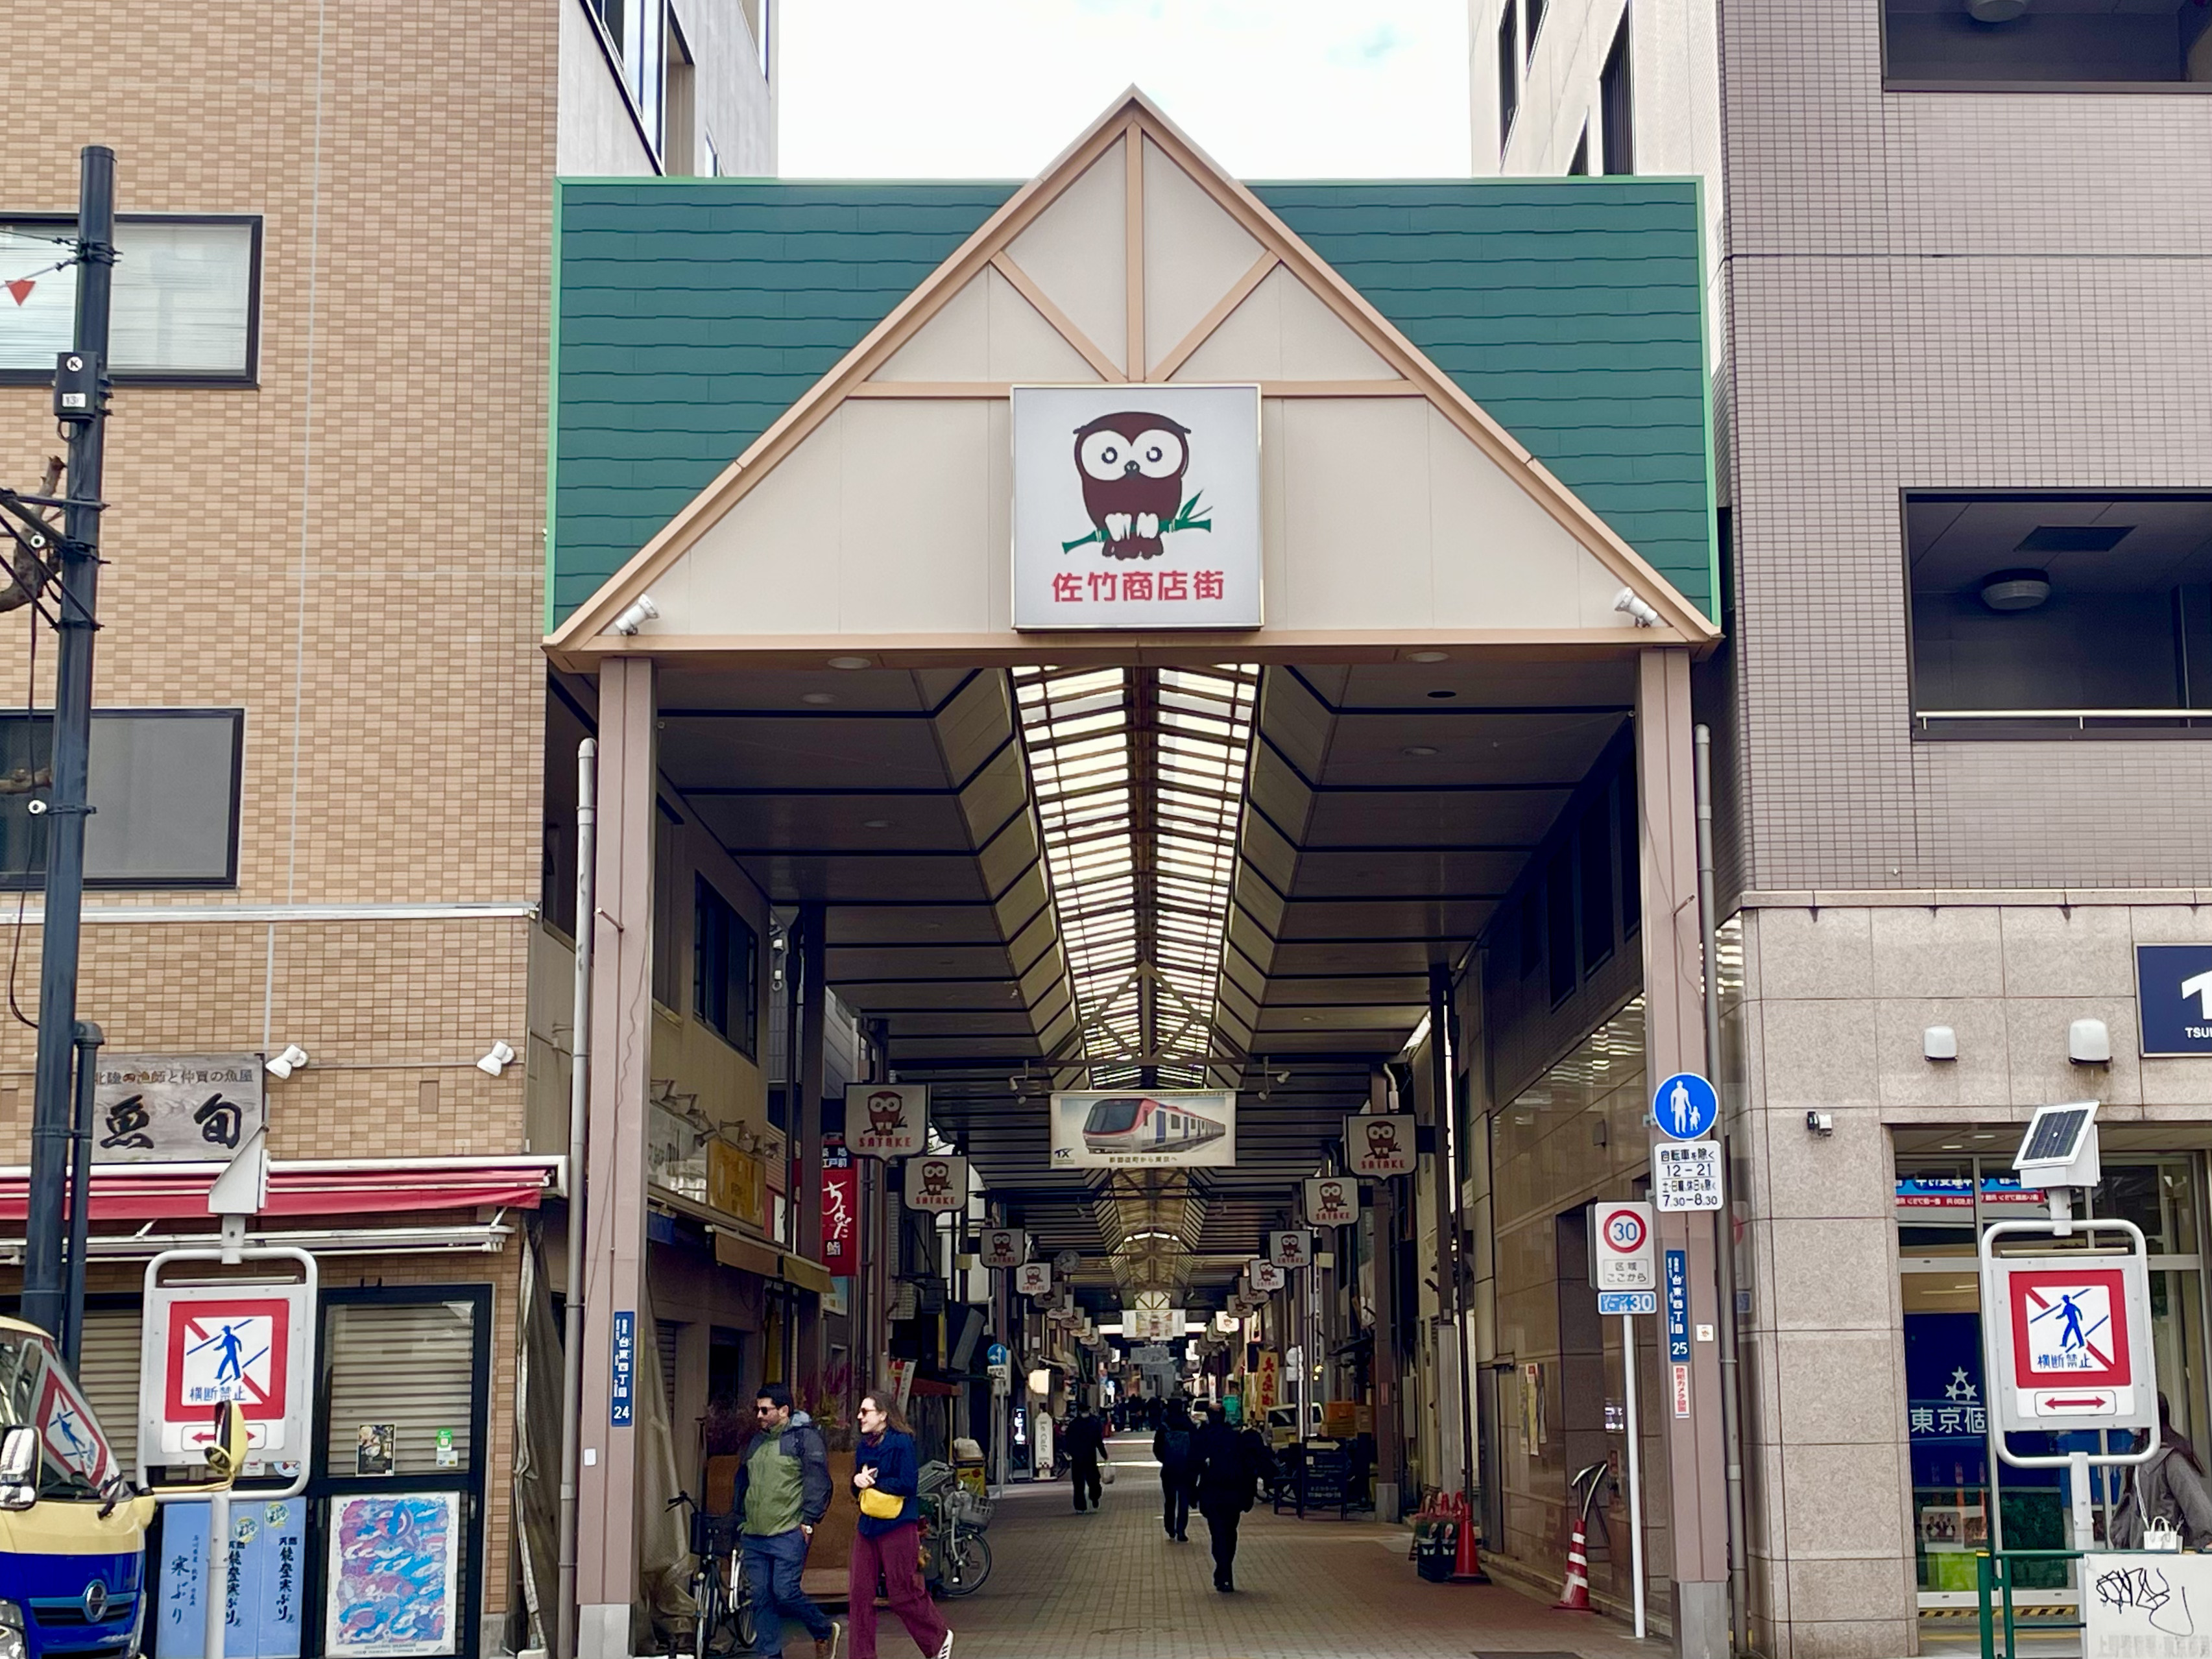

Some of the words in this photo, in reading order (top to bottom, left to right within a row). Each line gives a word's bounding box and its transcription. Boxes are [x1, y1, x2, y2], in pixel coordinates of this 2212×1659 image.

[1052, 571, 1224, 602] 佐竹商店街
[859, 1137, 911, 1147] SATAKE
[1360, 1160, 1404, 1169] SATAKE
[1613, 1222, 1637, 1241] 30
[1615, 1262, 1637, 1271] 区域
[1607, 1273, 1646, 1282] ここから
[1672, 1343, 1688, 1355] 25
[2038, 1353, 2093, 1368] 横断禁止
[189, 1385, 246, 1402] 横断禁止
[614, 1406, 629, 1418] 24
[171, 1555, 190, 1625] 寒ぶり
